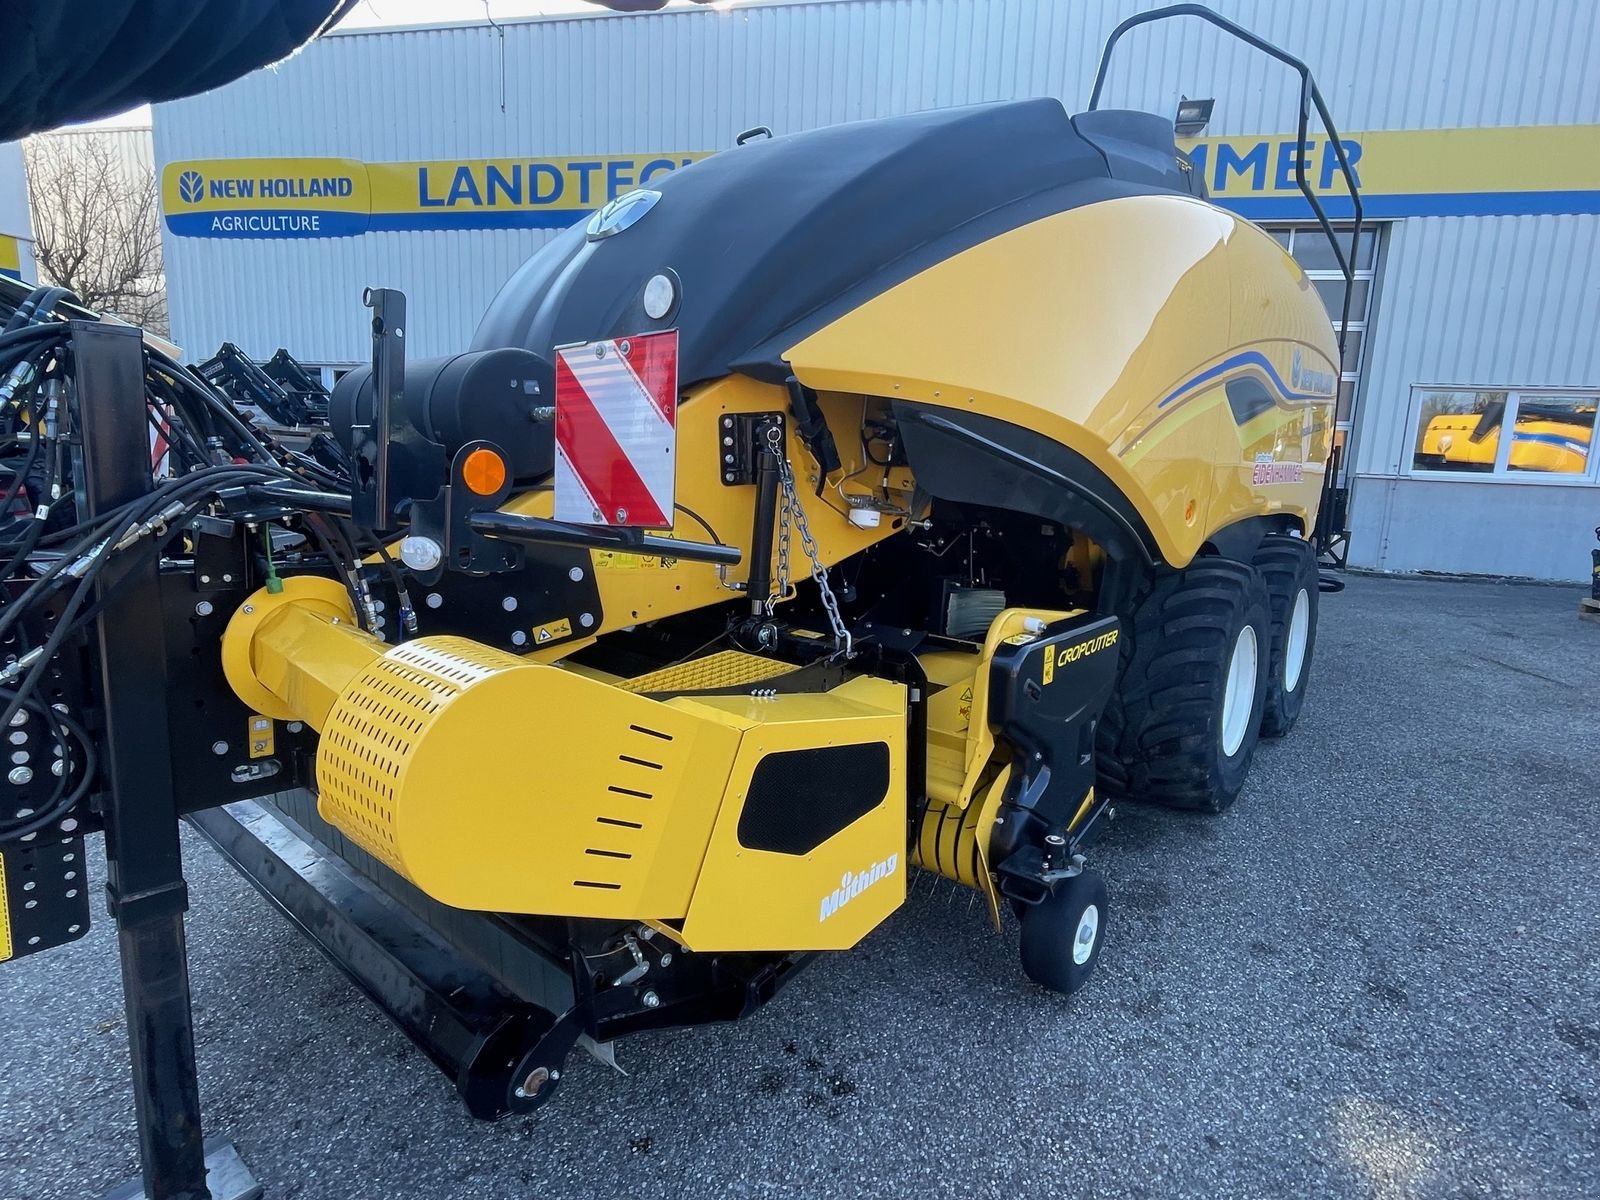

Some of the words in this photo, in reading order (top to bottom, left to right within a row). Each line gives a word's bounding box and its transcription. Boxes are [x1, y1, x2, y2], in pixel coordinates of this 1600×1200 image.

[209, 178, 254, 198] NEW
[259, 177, 353, 198] HOLLAND
[211, 215, 320, 231] AGRICULTURE
[1057, 629, 1119, 667] CROPCUTTER
[819, 852, 898, 923] Müthing
